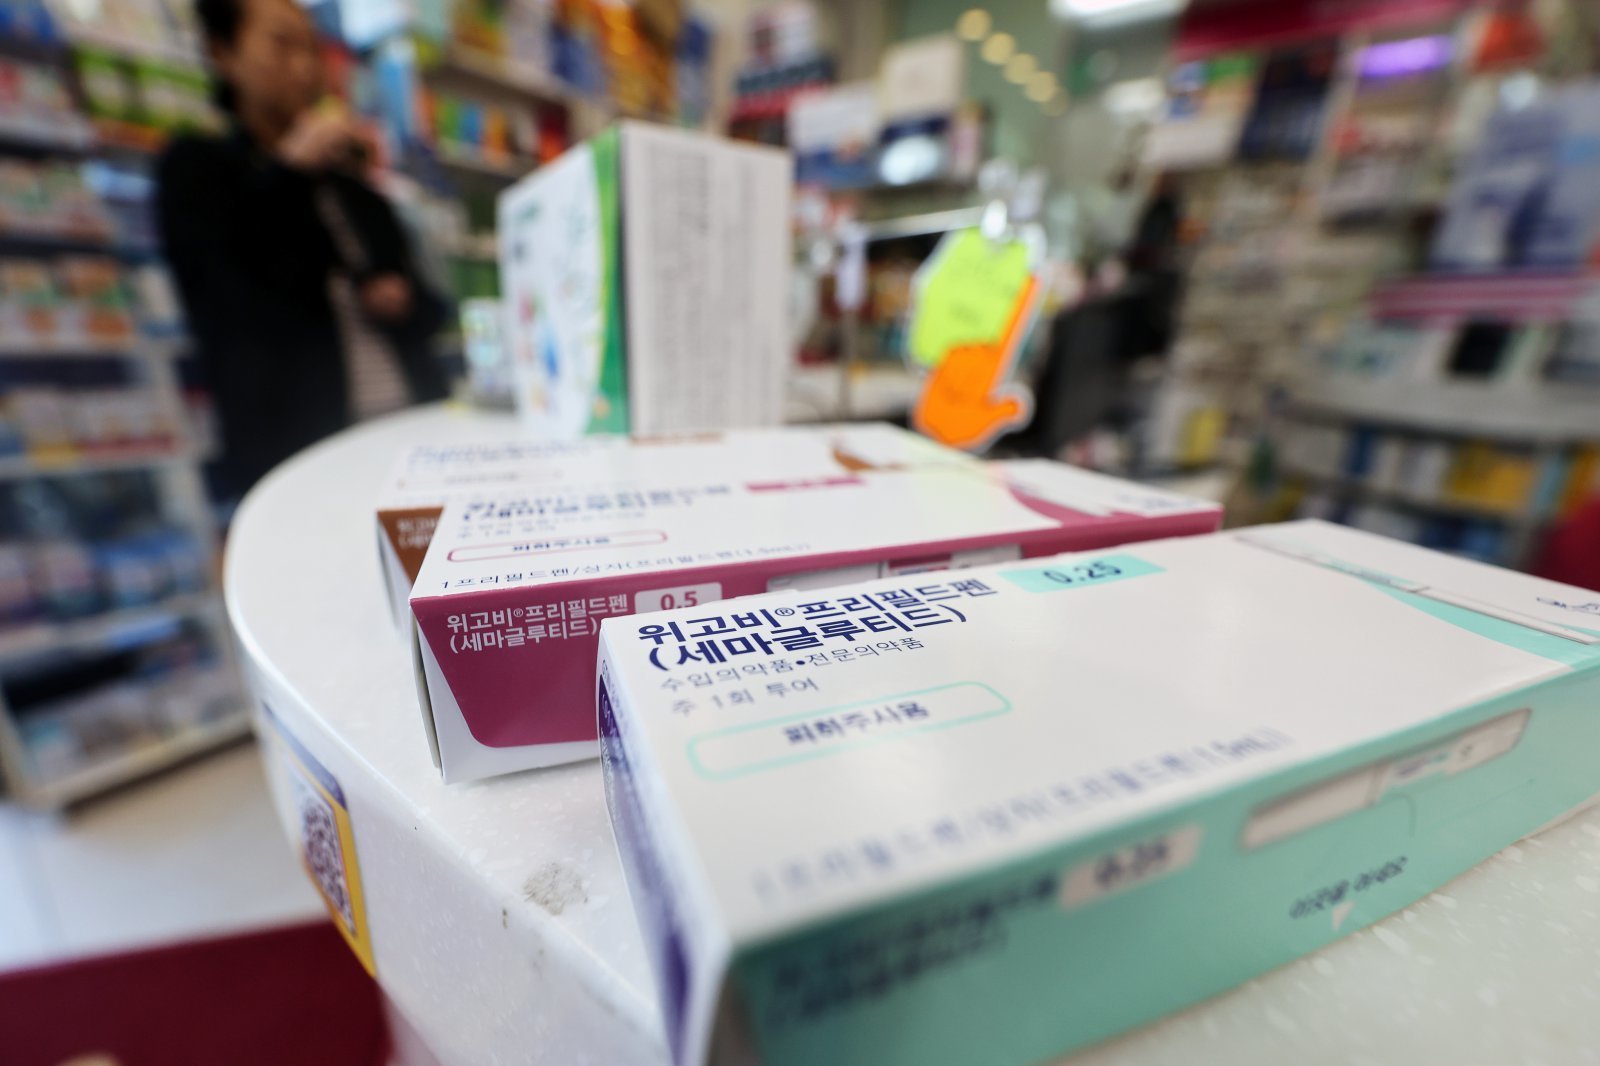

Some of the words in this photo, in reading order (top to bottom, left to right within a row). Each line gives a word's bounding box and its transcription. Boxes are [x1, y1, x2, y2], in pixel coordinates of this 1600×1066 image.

[1043, 560, 1123, 584] 0.25
[659, 590, 699, 610] 0.5
[449, 617, 598, 654] (세마글루티드)
[648, 603, 967, 671] (세마글루티드)
[672, 698, 697, 717] 주
[765, 676, 820, 698] 투여
